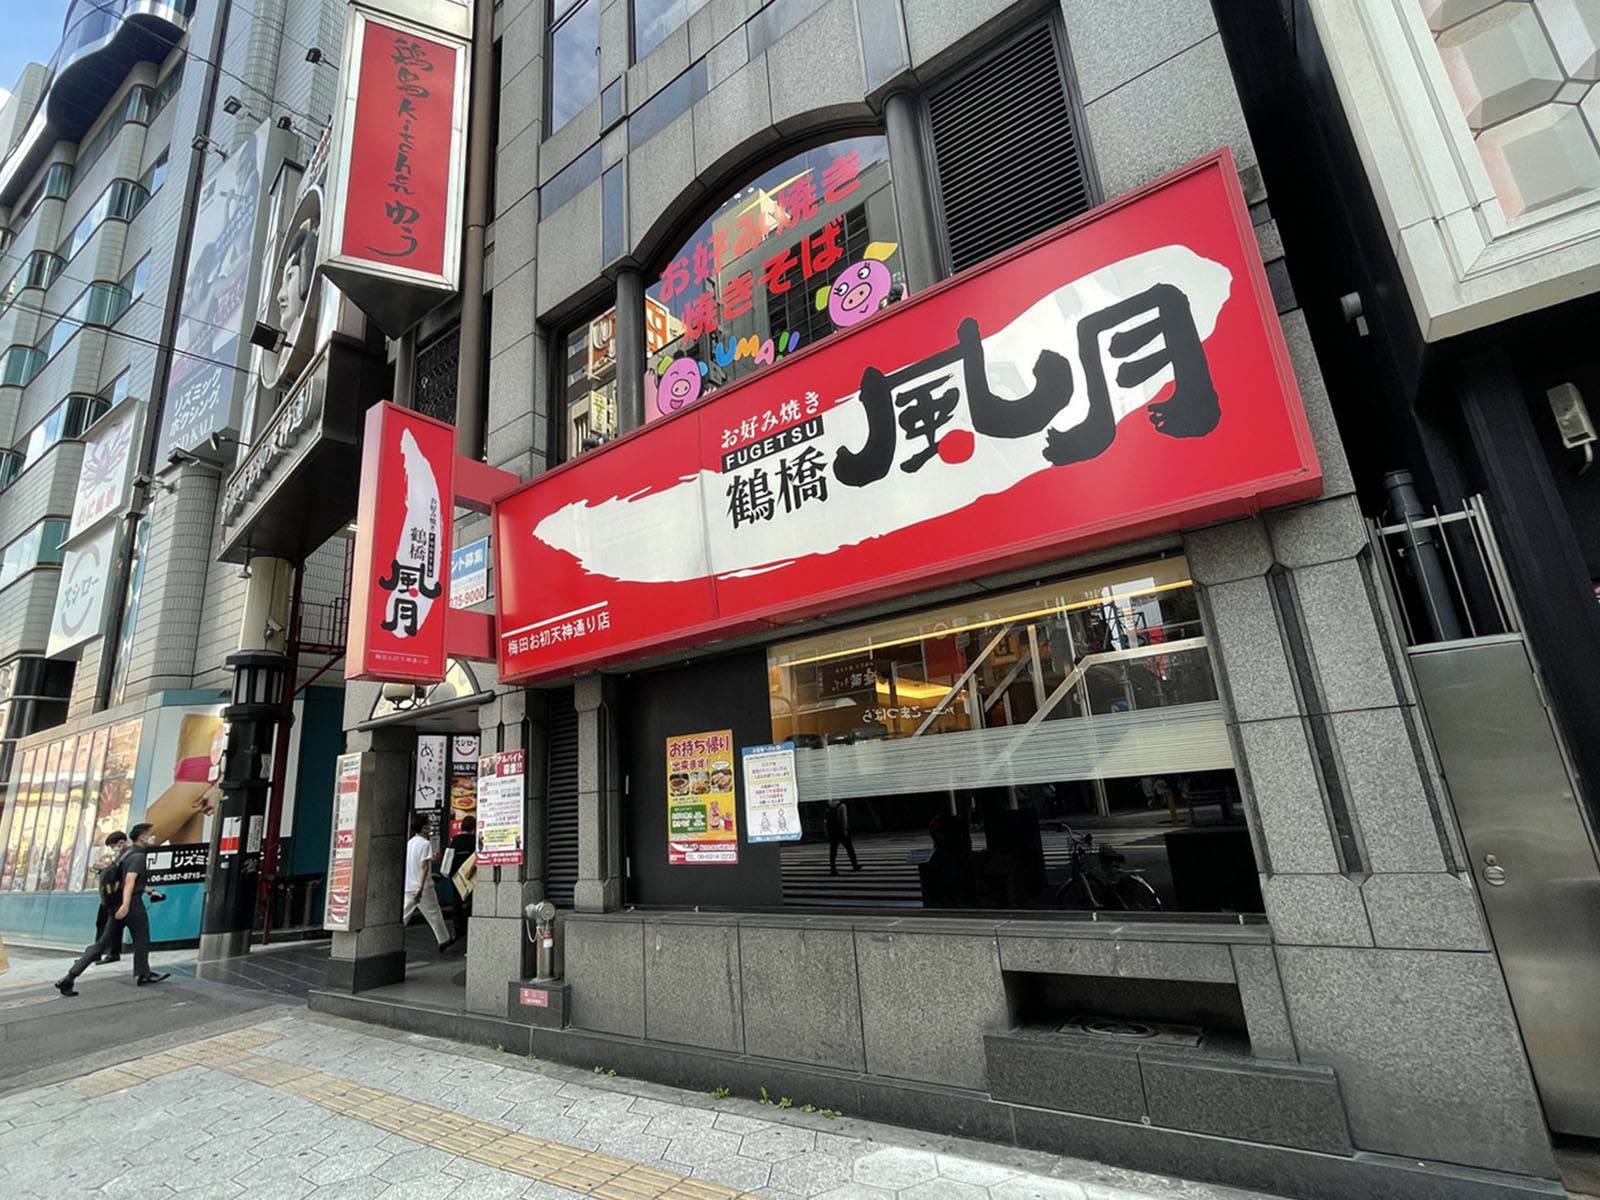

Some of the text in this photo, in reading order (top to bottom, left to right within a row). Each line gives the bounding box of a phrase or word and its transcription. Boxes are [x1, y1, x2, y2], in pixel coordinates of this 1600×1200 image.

[659, 151, 863, 302] お好み焼き
[682, 215, 843, 344] 焼きそば
[169, 385, 221, 437] ボクシング
[174, 368, 222, 417] リズミック
[721, 391, 819, 449] お好み焼き
[726, 283, 1221, 529] 鶴橋 風月
[726, 420, 817, 470] FUGETSU
[378, 559, 442, 637] 風月
[508, 611, 611, 656] 梅田お初天神通り店
[669, 735, 729, 758] お持ち帰り
